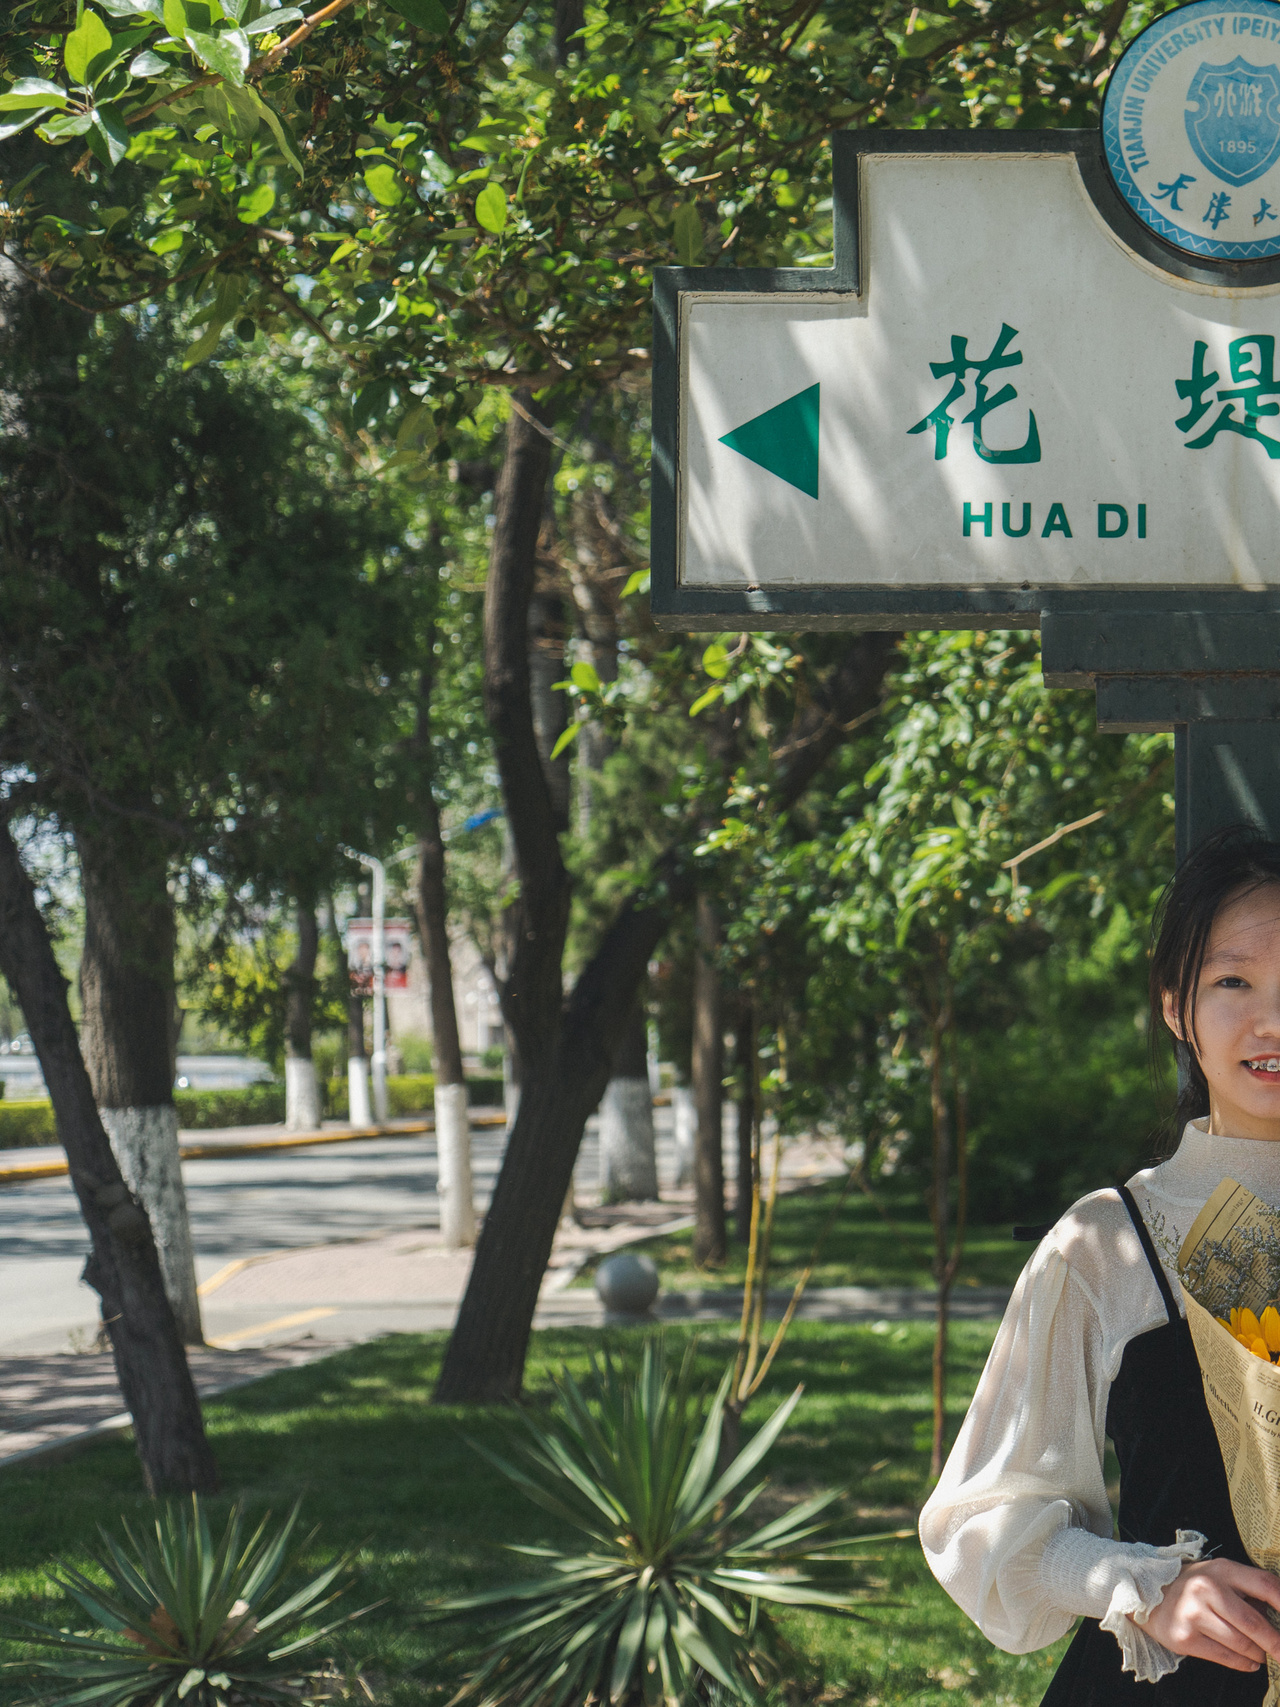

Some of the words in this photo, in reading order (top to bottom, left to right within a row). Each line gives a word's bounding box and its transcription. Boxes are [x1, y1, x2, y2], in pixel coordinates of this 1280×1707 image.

[1131, 17, 1226, 93] UNIVERSITY
[1124, 97, 1149, 173] TIANJIN
[1218, 140, 1257, 154] 1895
[962, 502, 1072, 539] HUA
[1097, 503, 1146, 539] DI
